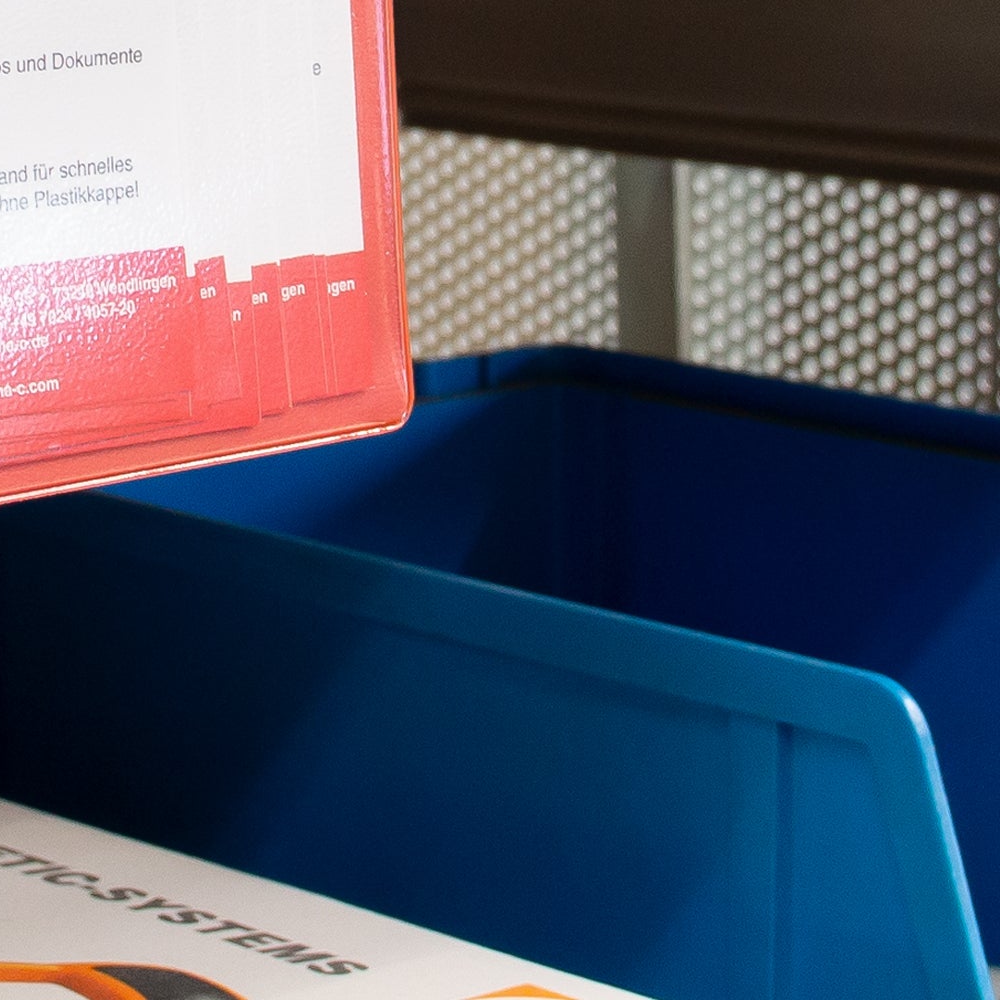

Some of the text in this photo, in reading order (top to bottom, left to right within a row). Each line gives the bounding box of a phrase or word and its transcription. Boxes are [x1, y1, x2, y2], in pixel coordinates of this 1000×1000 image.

[16, 52, 48, 74] und
[51, 47, 143, 70] Dokumente
[32, 161, 55, 181] für
[59, 155, 134, 179] schnelles
